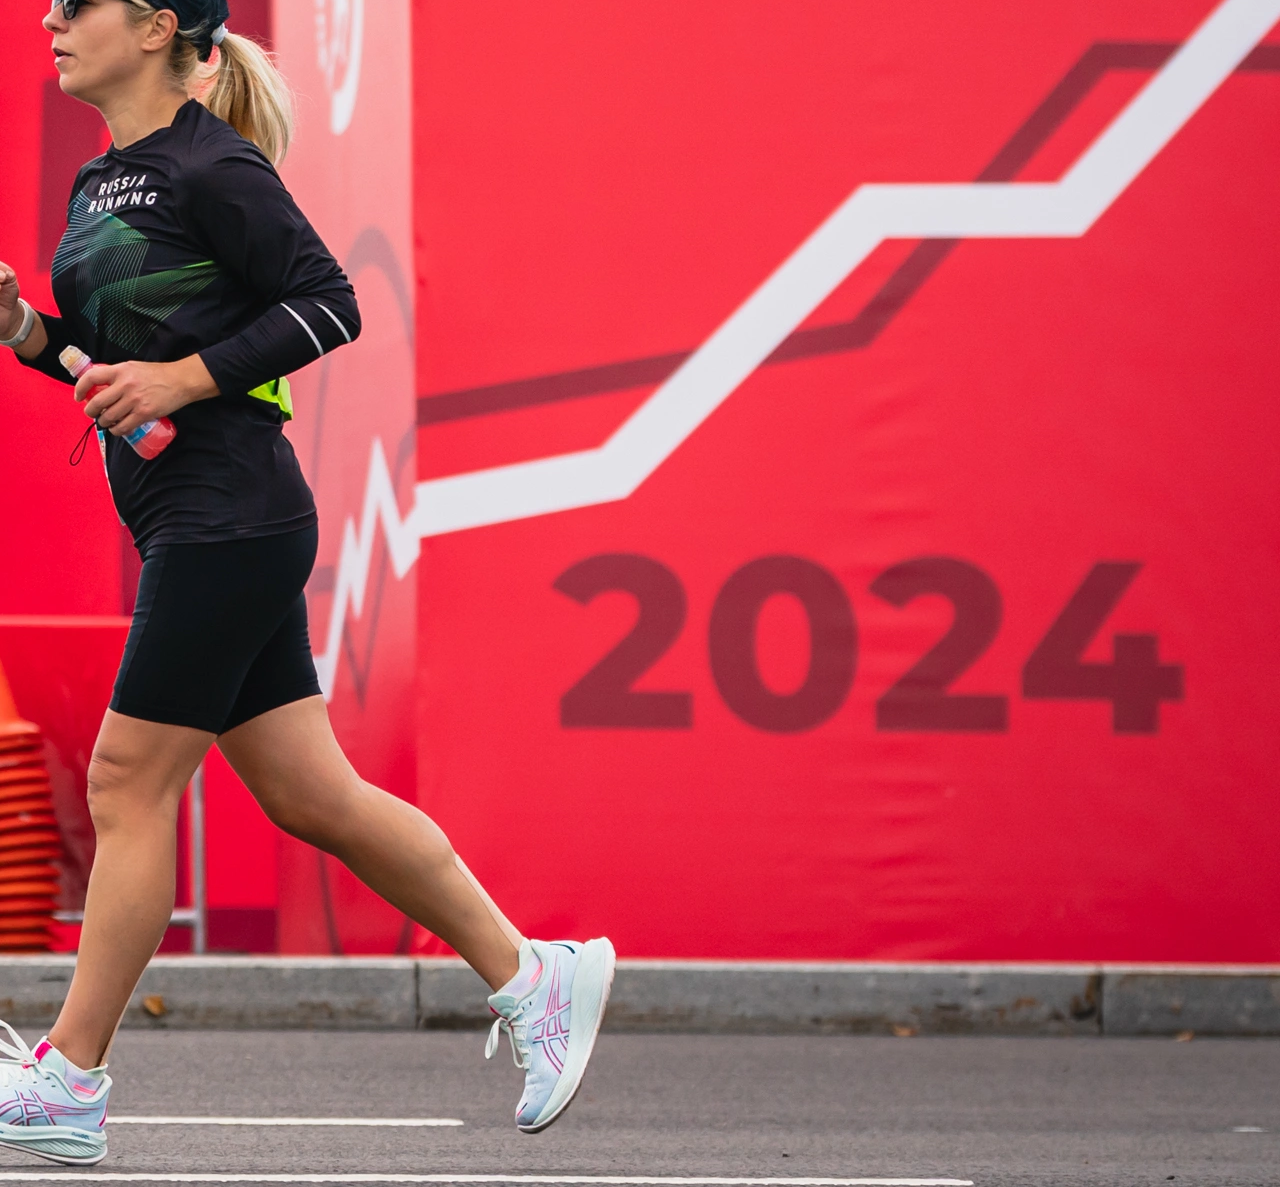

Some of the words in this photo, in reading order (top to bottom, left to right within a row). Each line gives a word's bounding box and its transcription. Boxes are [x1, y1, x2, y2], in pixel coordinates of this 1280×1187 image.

[98, 174, 146, 196] RUSSIA
[88, 191, 158, 213] RUNNING
[550, 553, 1185, 735] 2024
